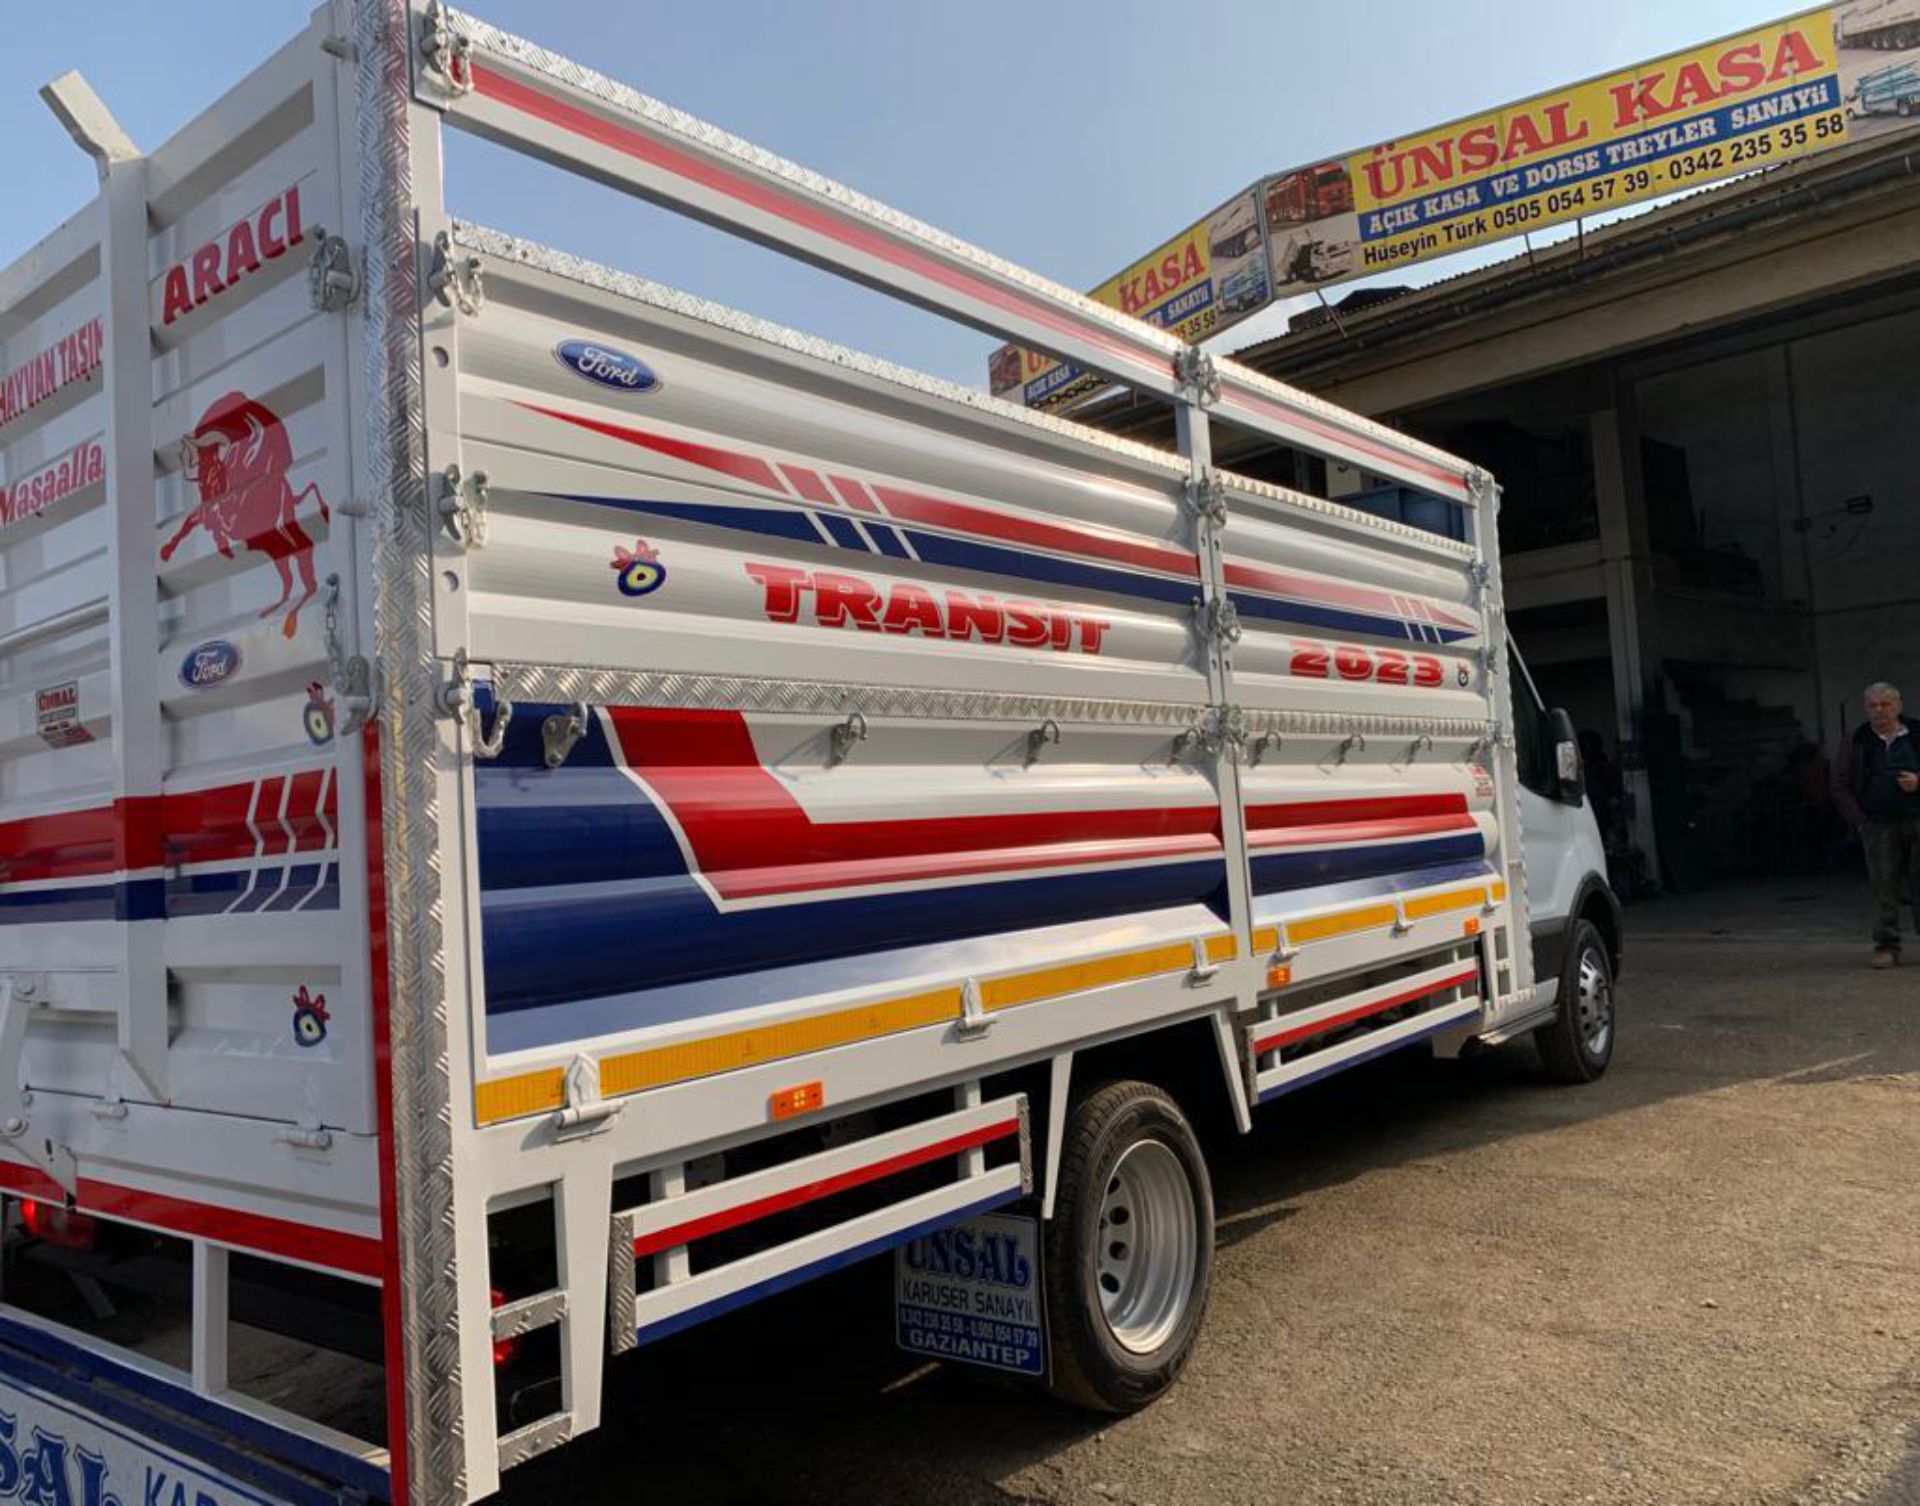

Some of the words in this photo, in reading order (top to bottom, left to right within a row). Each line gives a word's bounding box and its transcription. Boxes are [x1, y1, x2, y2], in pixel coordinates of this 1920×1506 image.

[1362, 102, 1589, 200] ÜNSAL
[1609, 31, 1825, 128] KASA
[1363, 231, 1438, 265] Hüseyin
[1442, 216, 1489, 243] Türk
[1493, 200, 1541, 229] 0505
[1548, 188, 1585, 214] 054
[1591, 178, 1615, 202] 57
[1623, 170, 1649, 193] 39
[1670, 149, 1723, 180] 0342
[1730, 135, 1772, 163] 235
[1779, 123, 1807, 149] 35
[1815, 113, 1844, 138] 58
[1370, 203, 1419, 234] AÇIK
[1423, 186, 1481, 218] KASA
[1491, 175, 1519, 197] VE
[1526, 150, 1600, 189] DORSE
[1606, 118, 1718, 165] TREYLER
[163, 187, 304, 325] ARACI
[1118, 241, 1207, 315] KASA
[578, 347, 638, 385] Ford
[744, 561, 1111, 655] TRANSIT
[192, 650, 228, 682] Ford
[1289, 638, 1443, 687] 2023
[903, 1277, 969, 1312] KARUSER
